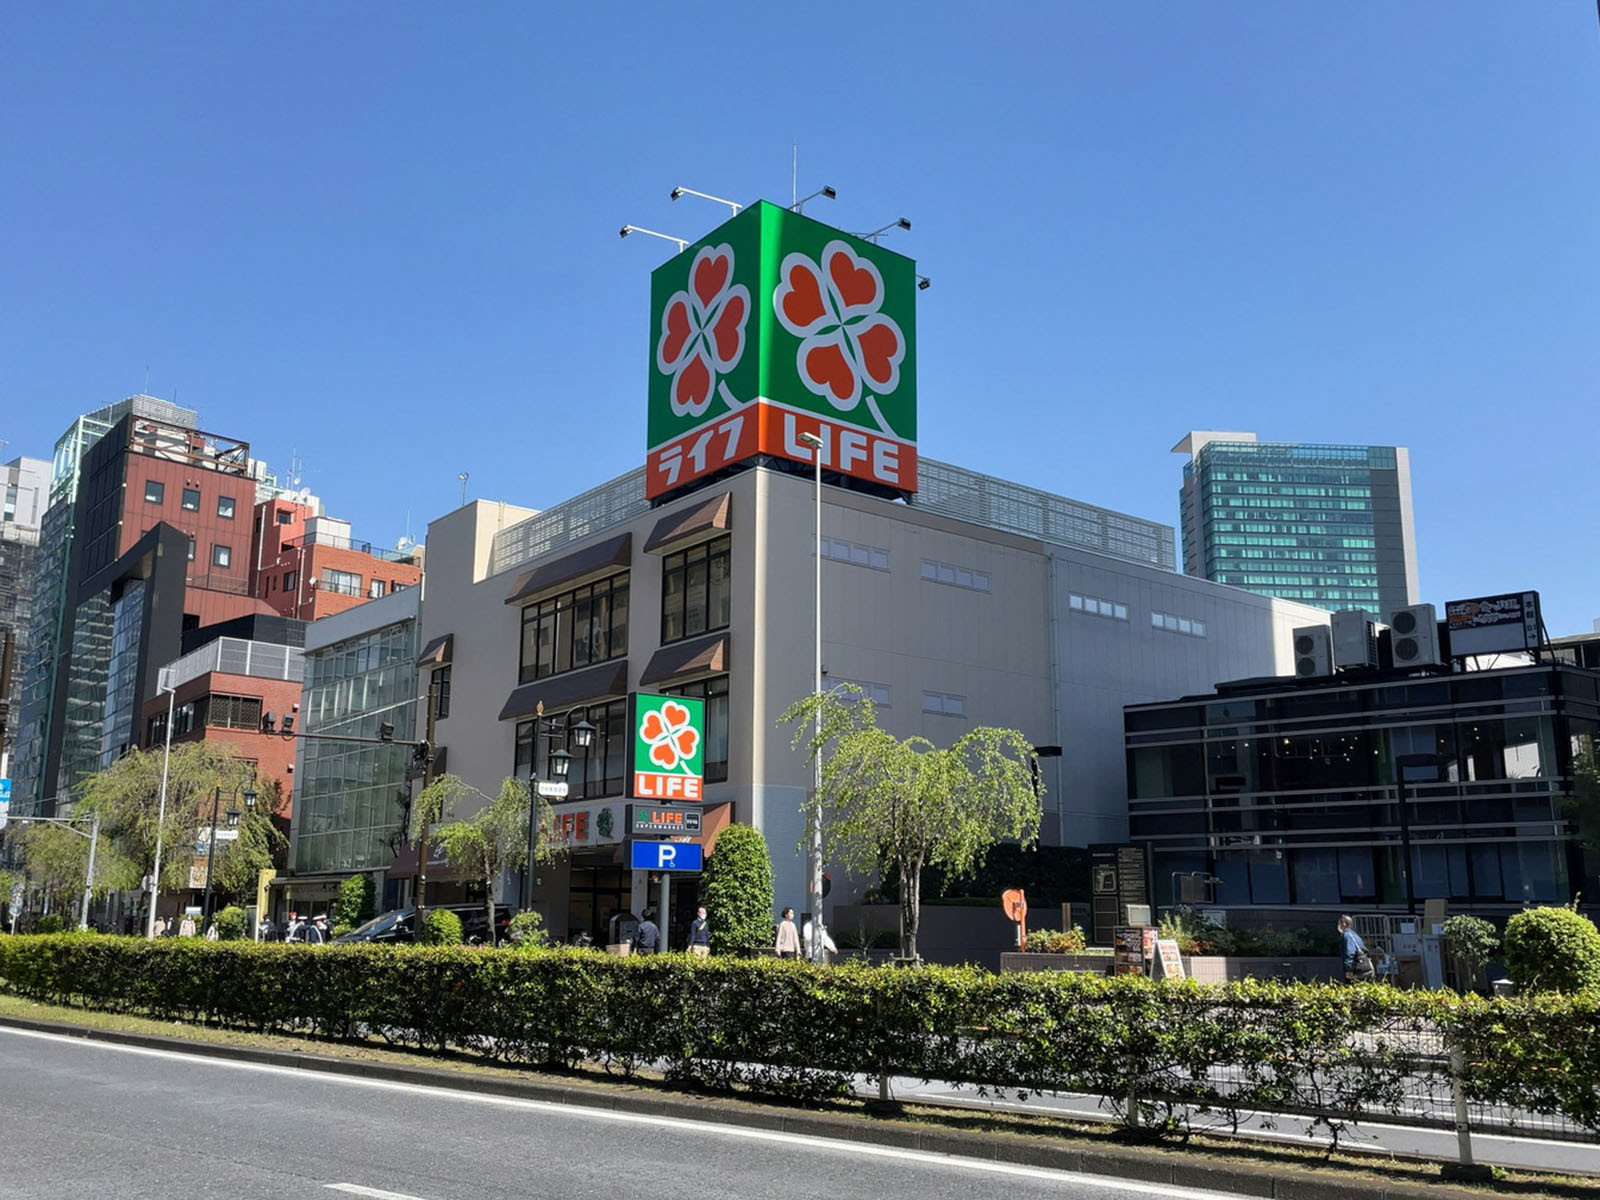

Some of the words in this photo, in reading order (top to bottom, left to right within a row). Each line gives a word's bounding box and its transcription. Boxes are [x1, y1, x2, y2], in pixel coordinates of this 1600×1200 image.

[658, 416, 744, 486] ライフ
[783, 414, 900, 484] LIFE
[638, 775, 700, 798] LIFE
[635, 823, 684, 831] SUPERMARKET
[652, 811, 684, 824] LIFE
[658, 844, 677, 868] P
